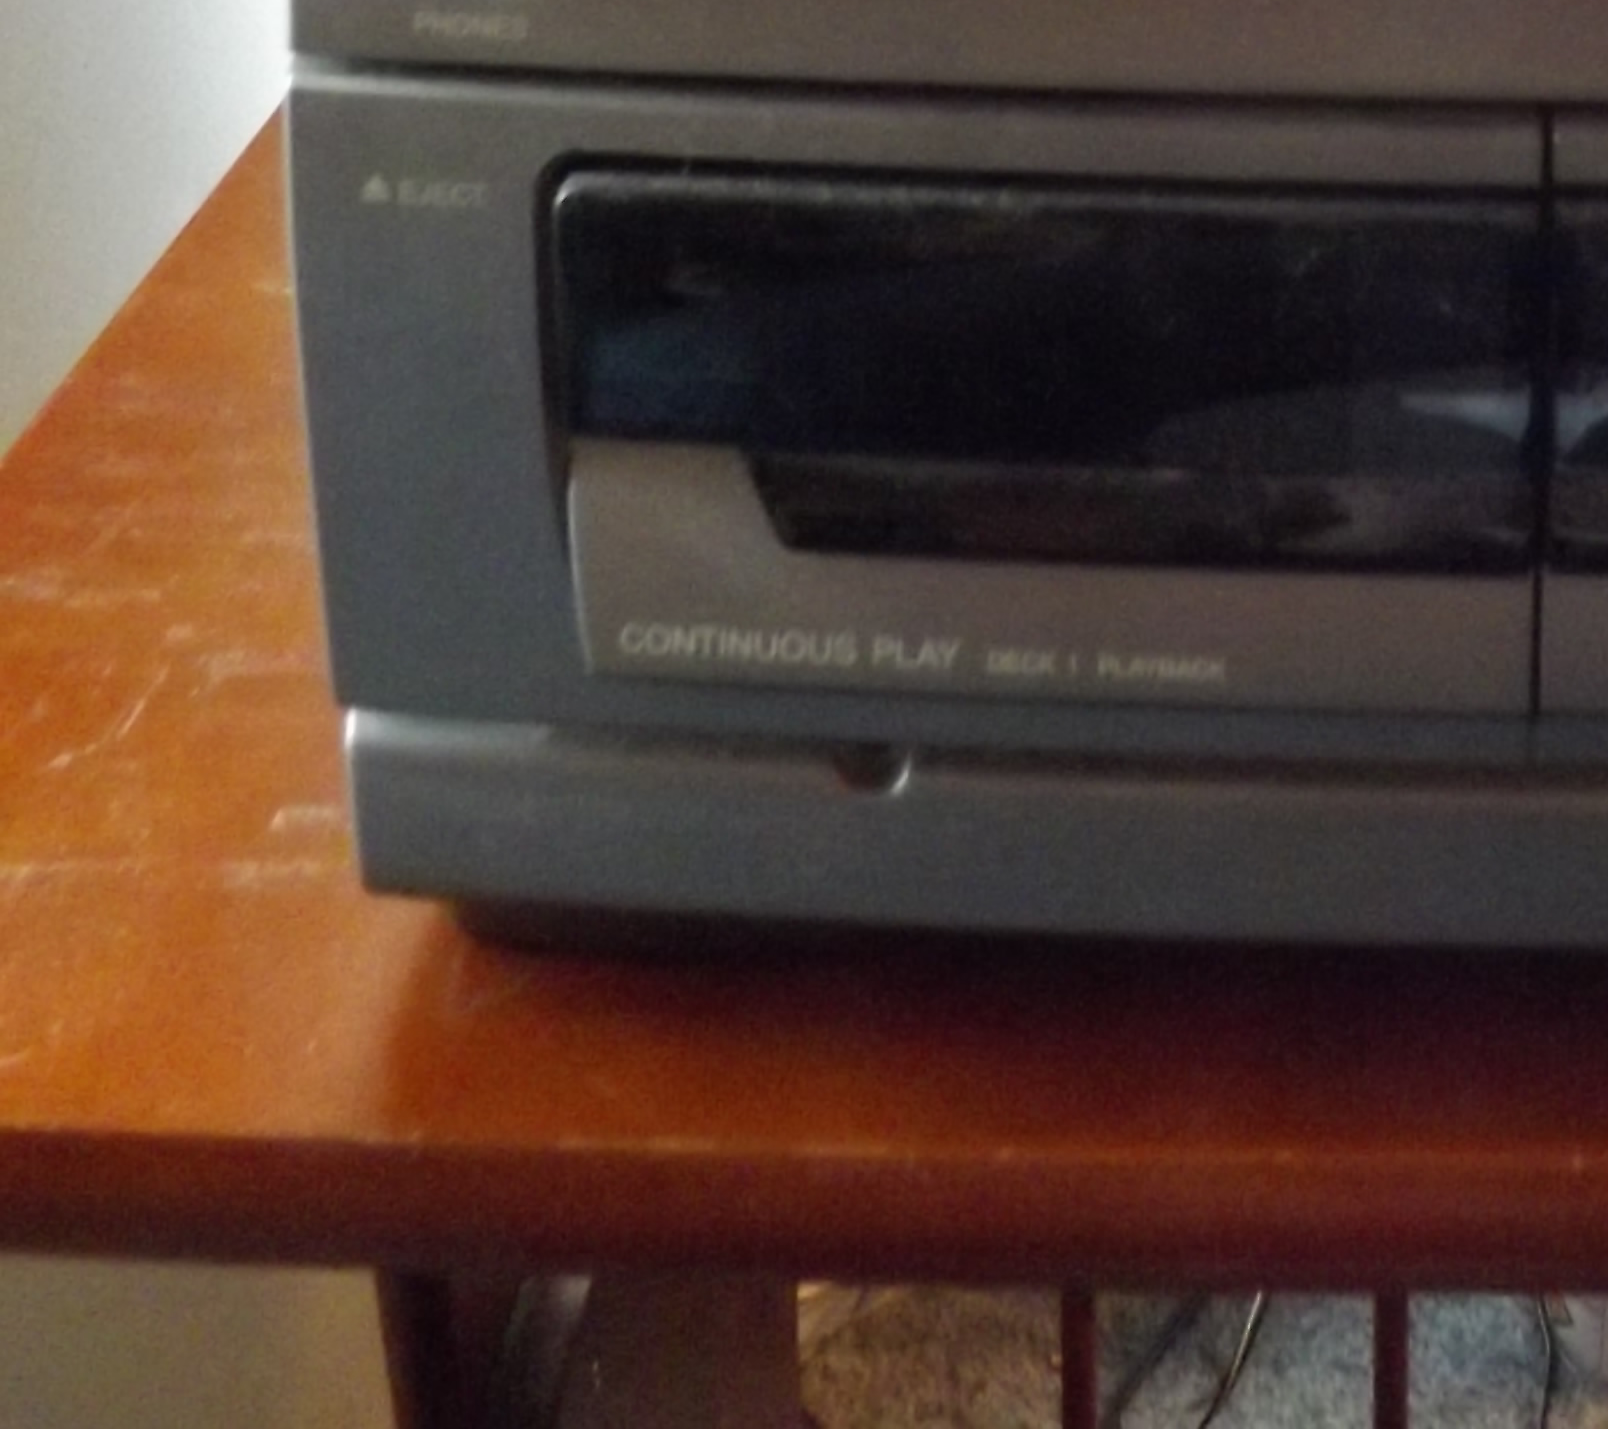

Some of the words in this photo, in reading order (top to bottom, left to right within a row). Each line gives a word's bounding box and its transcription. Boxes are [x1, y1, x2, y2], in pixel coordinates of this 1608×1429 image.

[619, 621, 857, 667] CONTINUOUS
[871, 633, 964, 671] PLAY
[987, 650, 1056, 678] DECK
[1097, 652, 1226, 682] PLAYBACK
